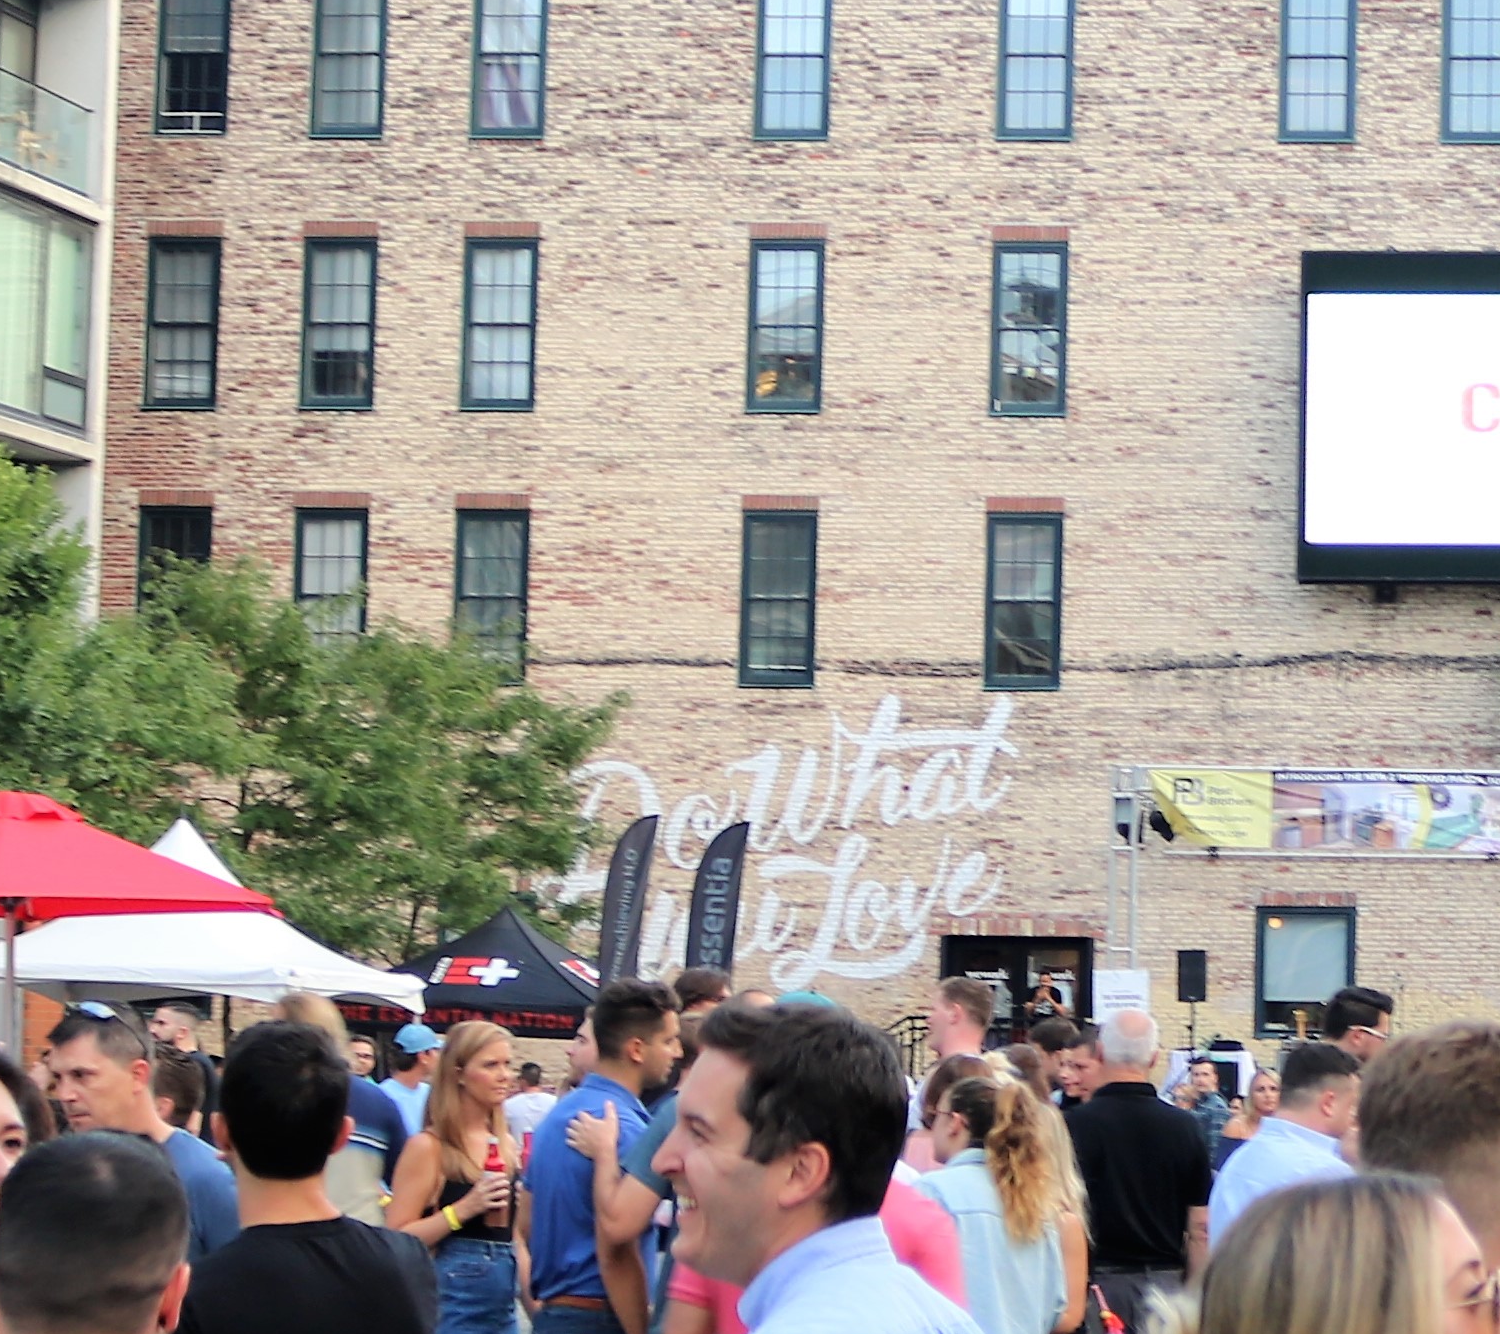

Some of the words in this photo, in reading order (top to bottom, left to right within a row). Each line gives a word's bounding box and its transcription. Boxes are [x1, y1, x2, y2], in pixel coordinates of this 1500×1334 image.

[723, 693, 1020, 853] What
[700, 857, 733, 971] ssentia
[756, 831, 1003, 992] Love
